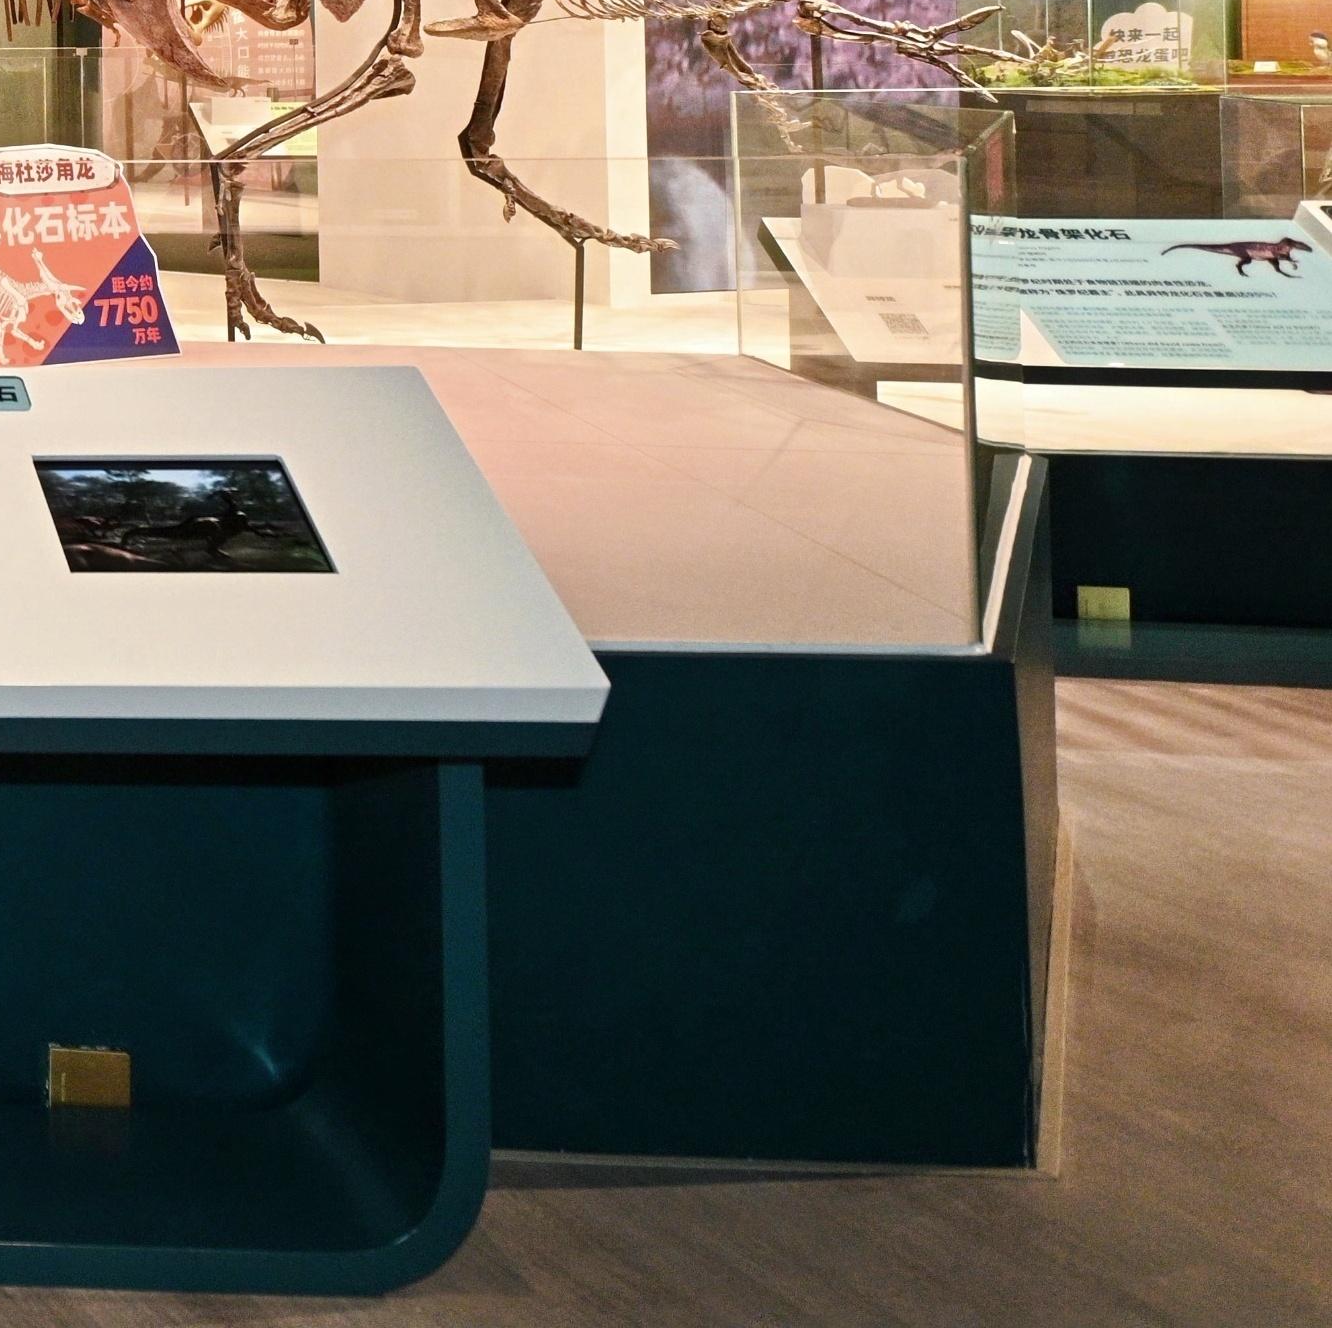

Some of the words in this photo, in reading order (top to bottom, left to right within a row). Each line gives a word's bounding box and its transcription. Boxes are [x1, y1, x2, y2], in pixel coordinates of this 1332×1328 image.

[111, 274, 154, 295] 距今约
[94, 296, 159, 328] 7750
[133, 327, 162, 346] 万年
